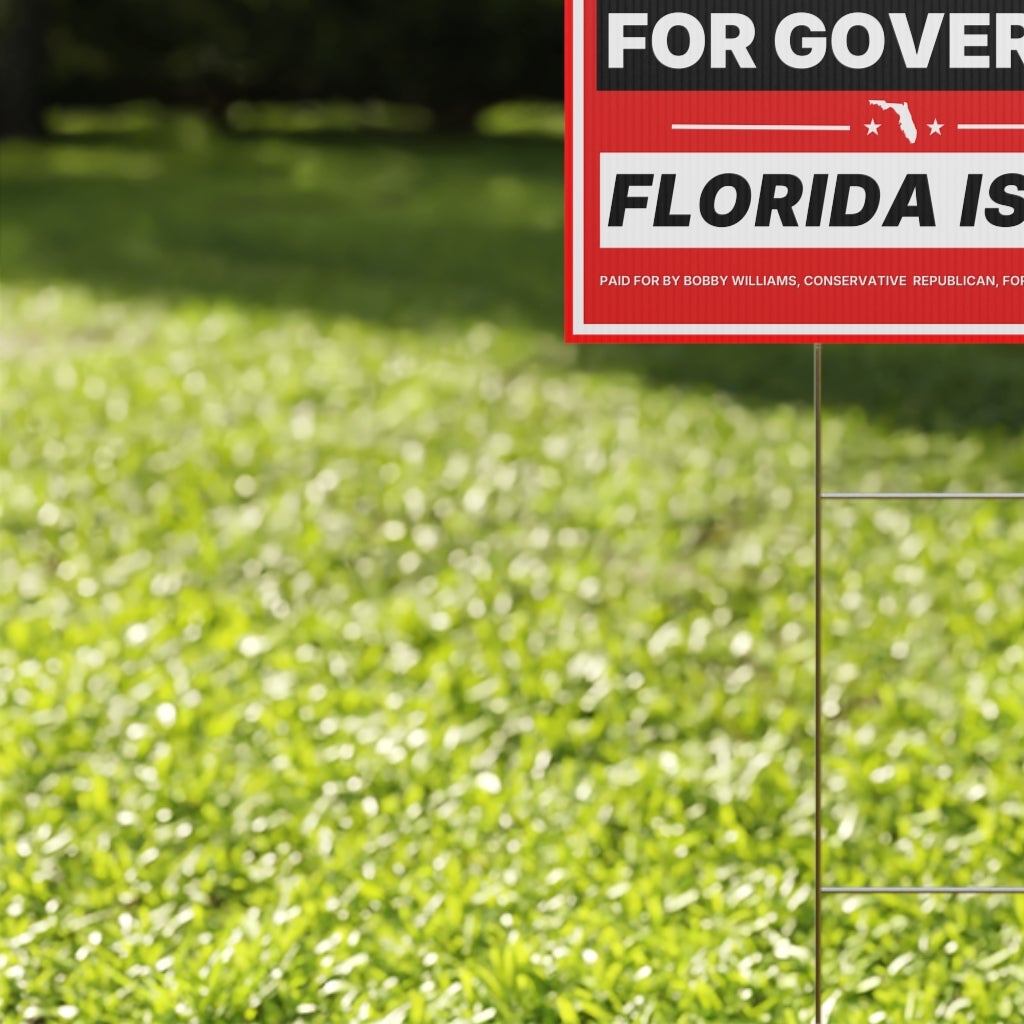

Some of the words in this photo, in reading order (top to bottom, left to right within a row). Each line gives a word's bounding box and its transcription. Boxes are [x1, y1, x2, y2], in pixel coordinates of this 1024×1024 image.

[608, 12, 756, 69] FOR
[608, 173, 935, 227] FLORIDA
[599, 275, 631, 286] PAID
[634, 275, 660, 286] FOR
[662, 275, 681, 286] BY
[683, 275, 729, 286] BOBBY
[731, 275, 801, 288] WILLIAMS,
[803, 275, 907, 286] CONSERVATIVE
[913, 275, 999, 288] REPUBLICAN,
